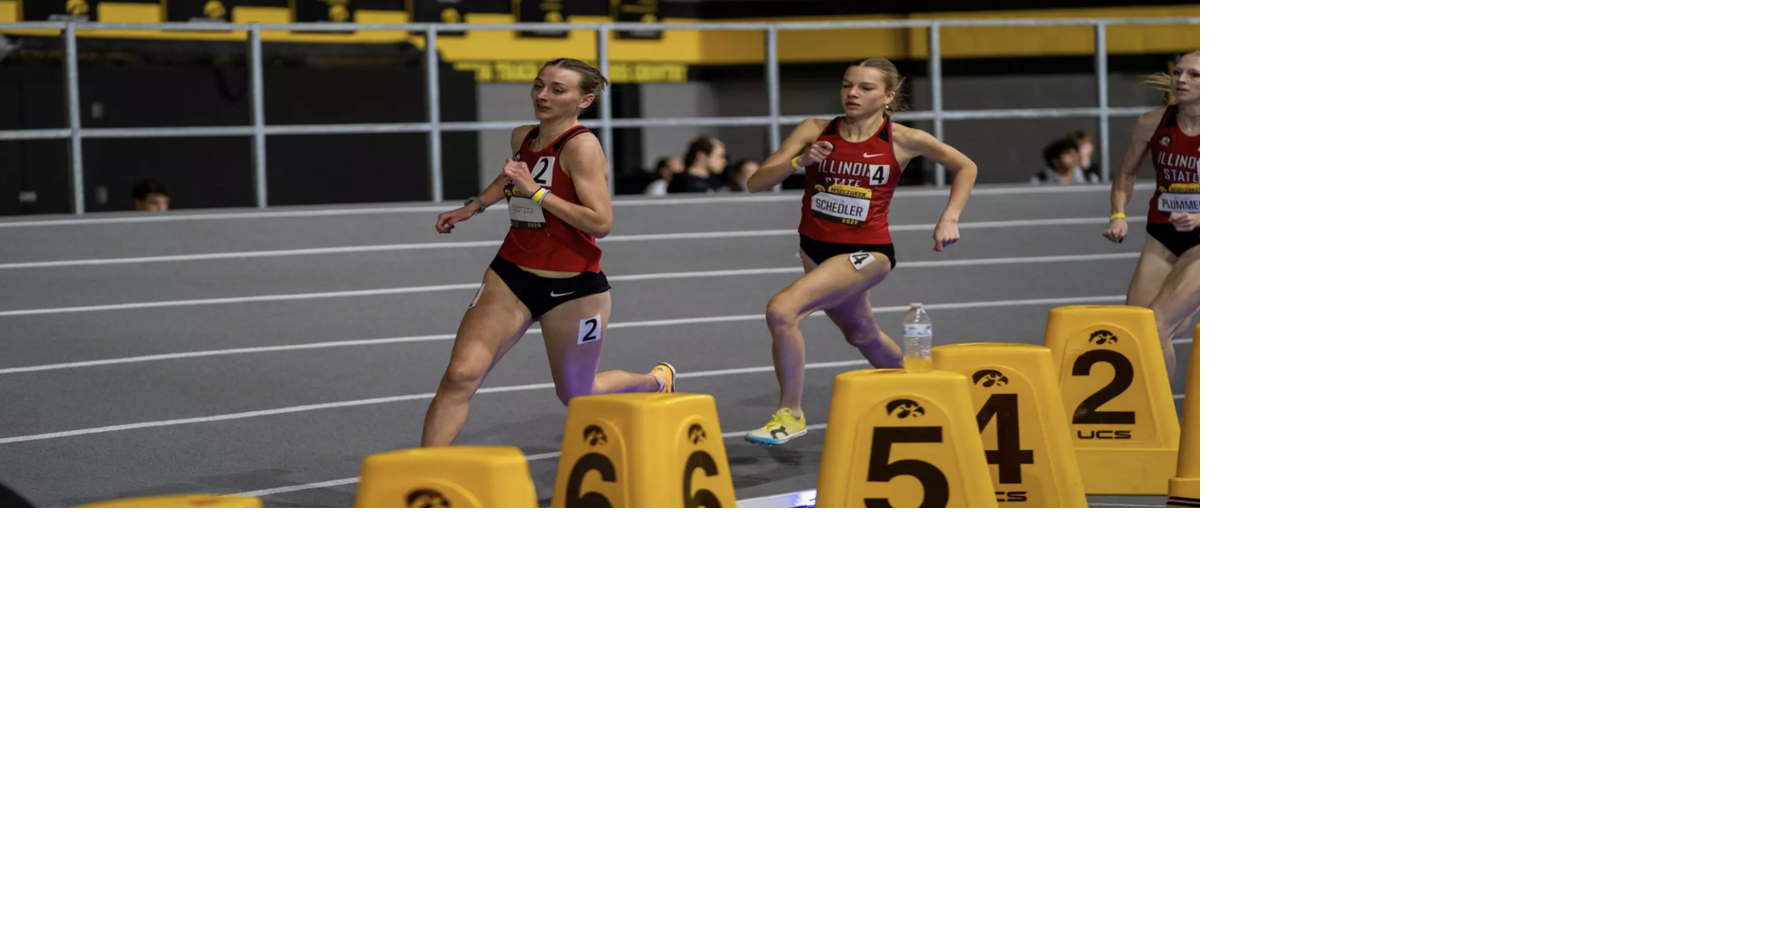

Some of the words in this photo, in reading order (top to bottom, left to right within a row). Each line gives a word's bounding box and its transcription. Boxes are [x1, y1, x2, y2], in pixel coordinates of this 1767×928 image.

[533, 158, 549, 184] 2
[1158, 152, 1198, 169] ILLINO
[871, 165, 885, 184] 4
[1164, 168, 1198, 182] STATE
[815, 198, 863, 217] SCHEDLER
[1161, 199, 1200, 210] PLUMME
[852, 253, 870, 265] 4
[582, 318, 598, 342] 2
[1071, 349, 1135, 424] 2
[976, 393, 1034, 484] 4
[1077, 430, 1131, 439] UCS
[863, 426, 949, 508] 5
[565, 452, 617, 508] 6
[683, 450, 722, 508] 6
